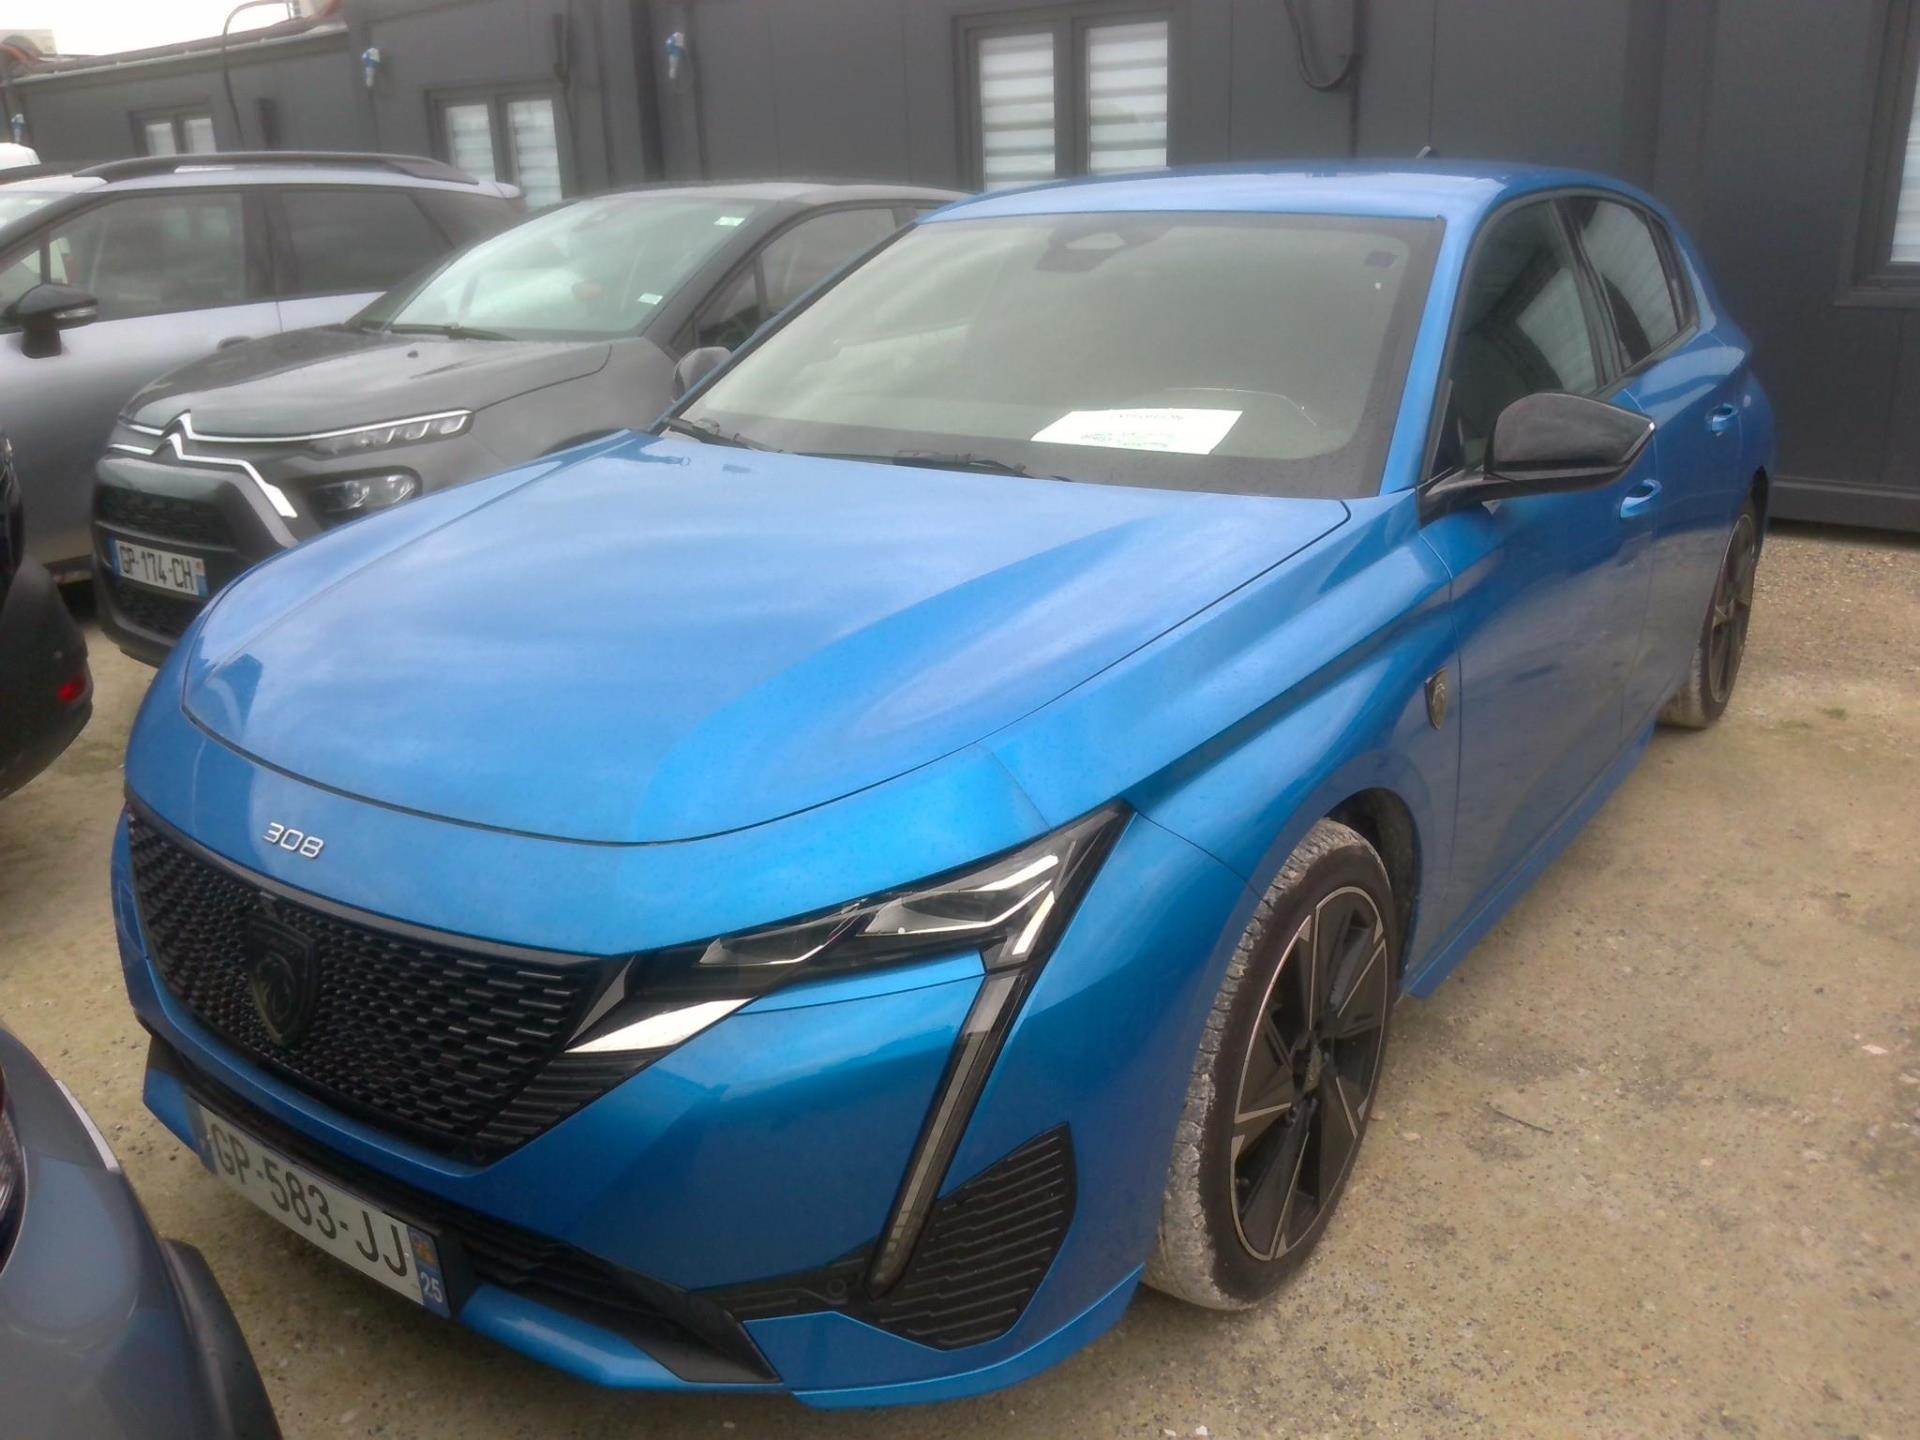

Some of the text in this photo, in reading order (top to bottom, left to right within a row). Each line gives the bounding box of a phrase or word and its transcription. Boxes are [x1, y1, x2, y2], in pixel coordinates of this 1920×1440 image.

[263, 822, 324, 858] 308
[211, 1123, 407, 1277] GP-583-JJ
[420, 1271, 443, 1303] 25
